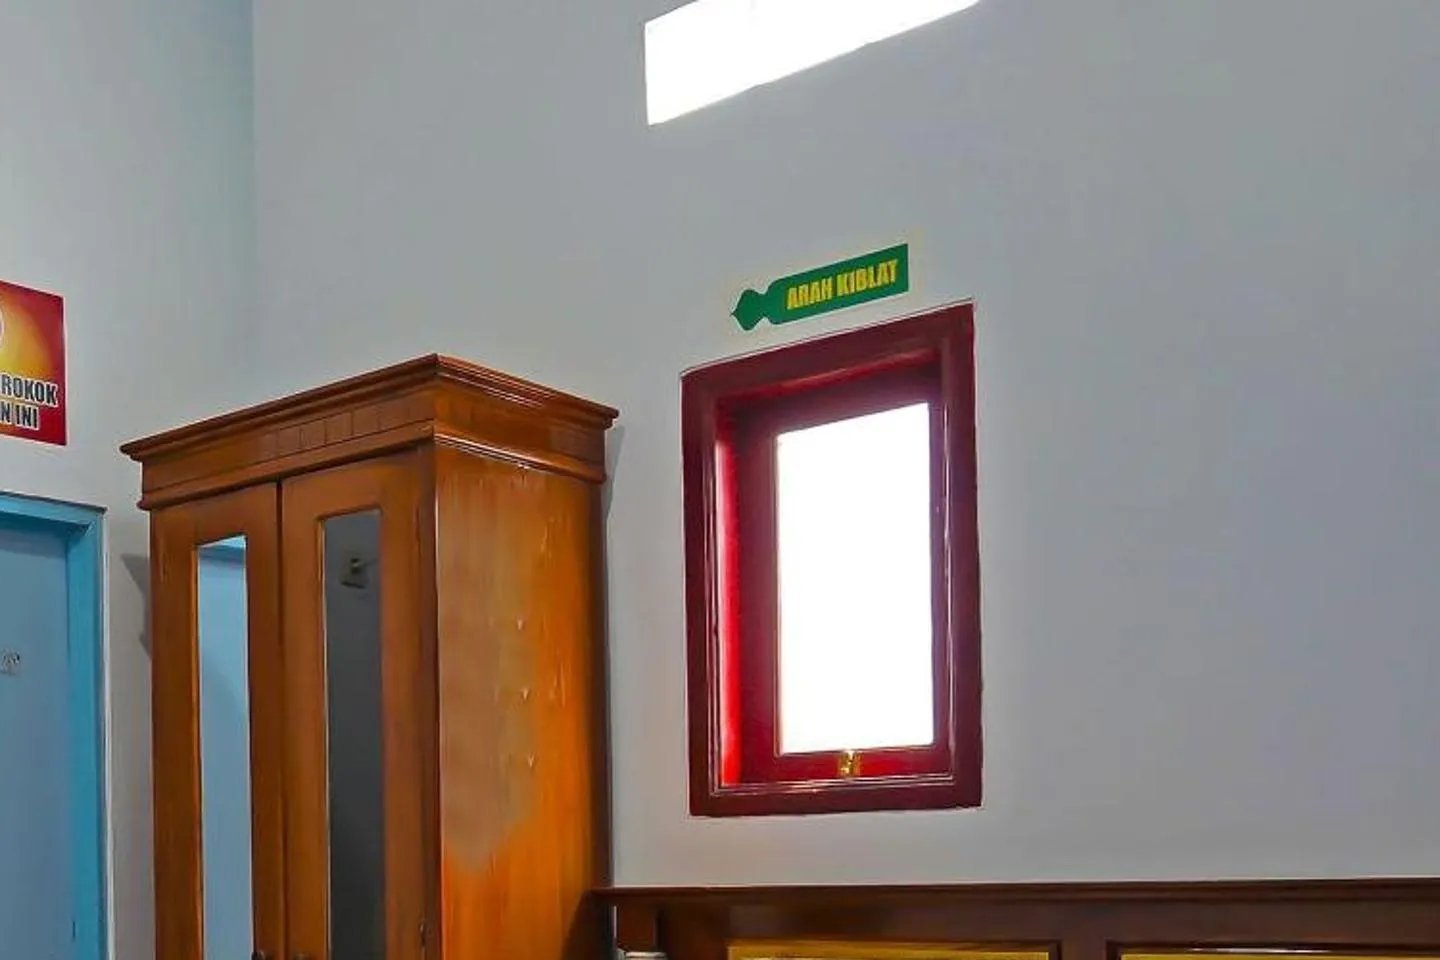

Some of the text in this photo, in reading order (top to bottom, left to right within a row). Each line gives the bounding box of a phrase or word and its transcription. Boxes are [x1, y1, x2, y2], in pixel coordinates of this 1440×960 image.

[787, 260, 897, 309] ARAH KIBLAT
[15, 403, 40, 429] INI
